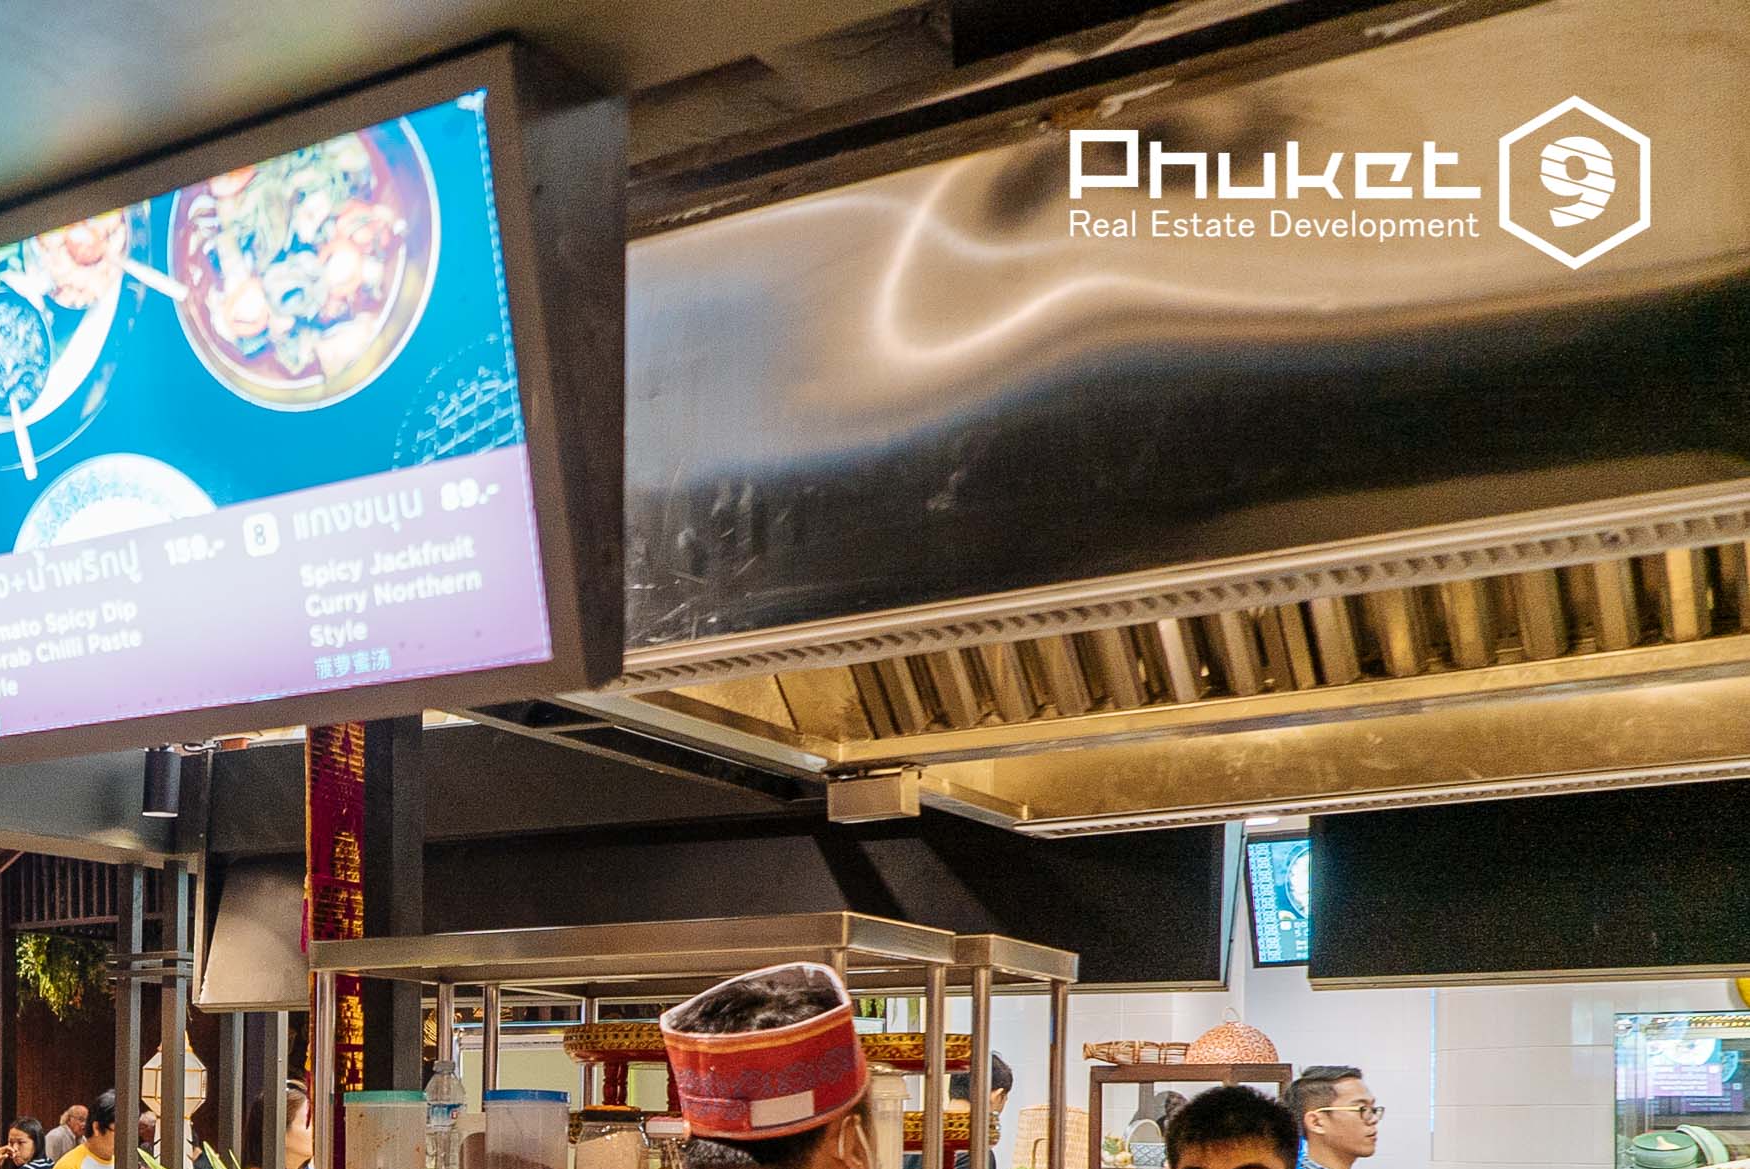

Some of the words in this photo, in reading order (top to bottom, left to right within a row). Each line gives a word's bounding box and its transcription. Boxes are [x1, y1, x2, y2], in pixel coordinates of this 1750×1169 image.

[292, 486, 423, 541] แกงขนุน
[299, 558, 364, 588] Spicy
[368, 534, 475, 576] Jackfruit
[305, 589, 369, 618] Curry
[373, 568, 483, 607] Northern
[45, 606, 97, 634] Spicy
[101, 597, 138, 625] Dip
[309, 619, 368, 649] Style
[36, 635, 85, 663] Chilli
[88, 628, 142, 655] Paste
